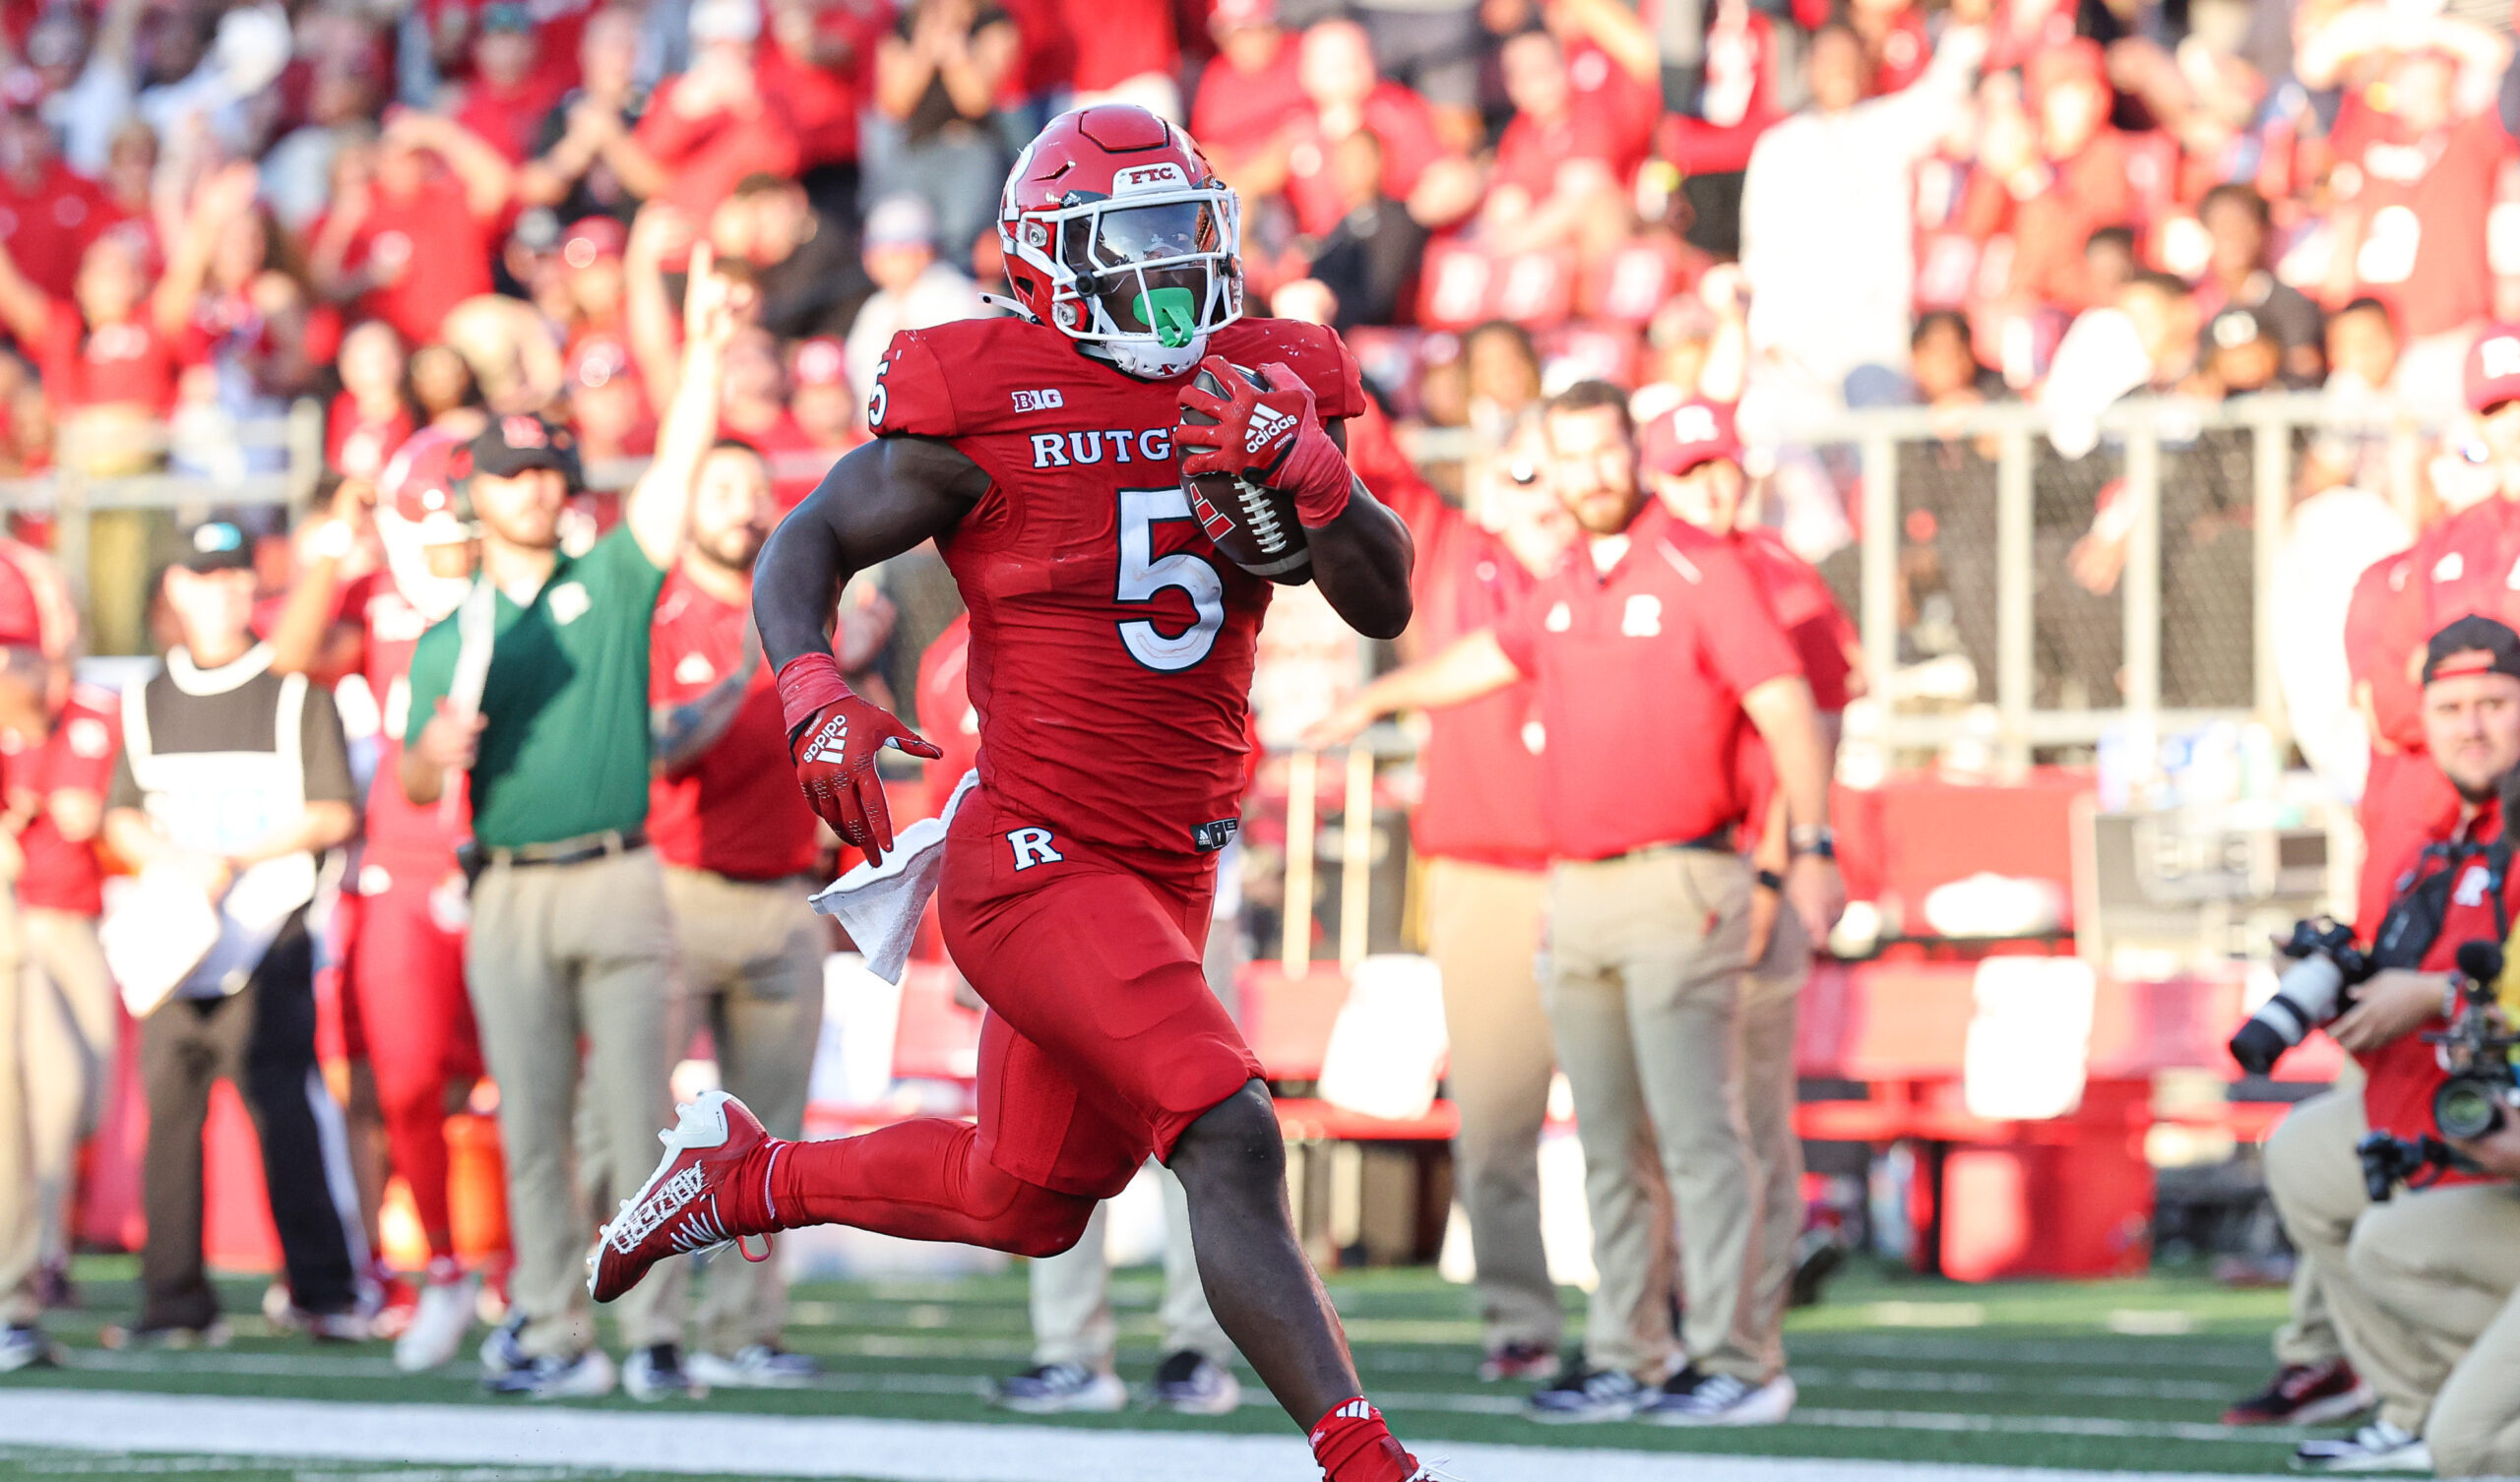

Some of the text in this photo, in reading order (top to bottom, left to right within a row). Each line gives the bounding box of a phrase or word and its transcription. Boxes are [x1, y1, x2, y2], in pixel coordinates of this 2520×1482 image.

[867, 359, 890, 428] 5
[1030, 426, 1177, 468] RUTG
[1246, 414, 1298, 453] adidas
[1114, 487, 1226, 674] 5
[802, 714, 847, 764] adidas
[1006, 827, 1064, 872] R
